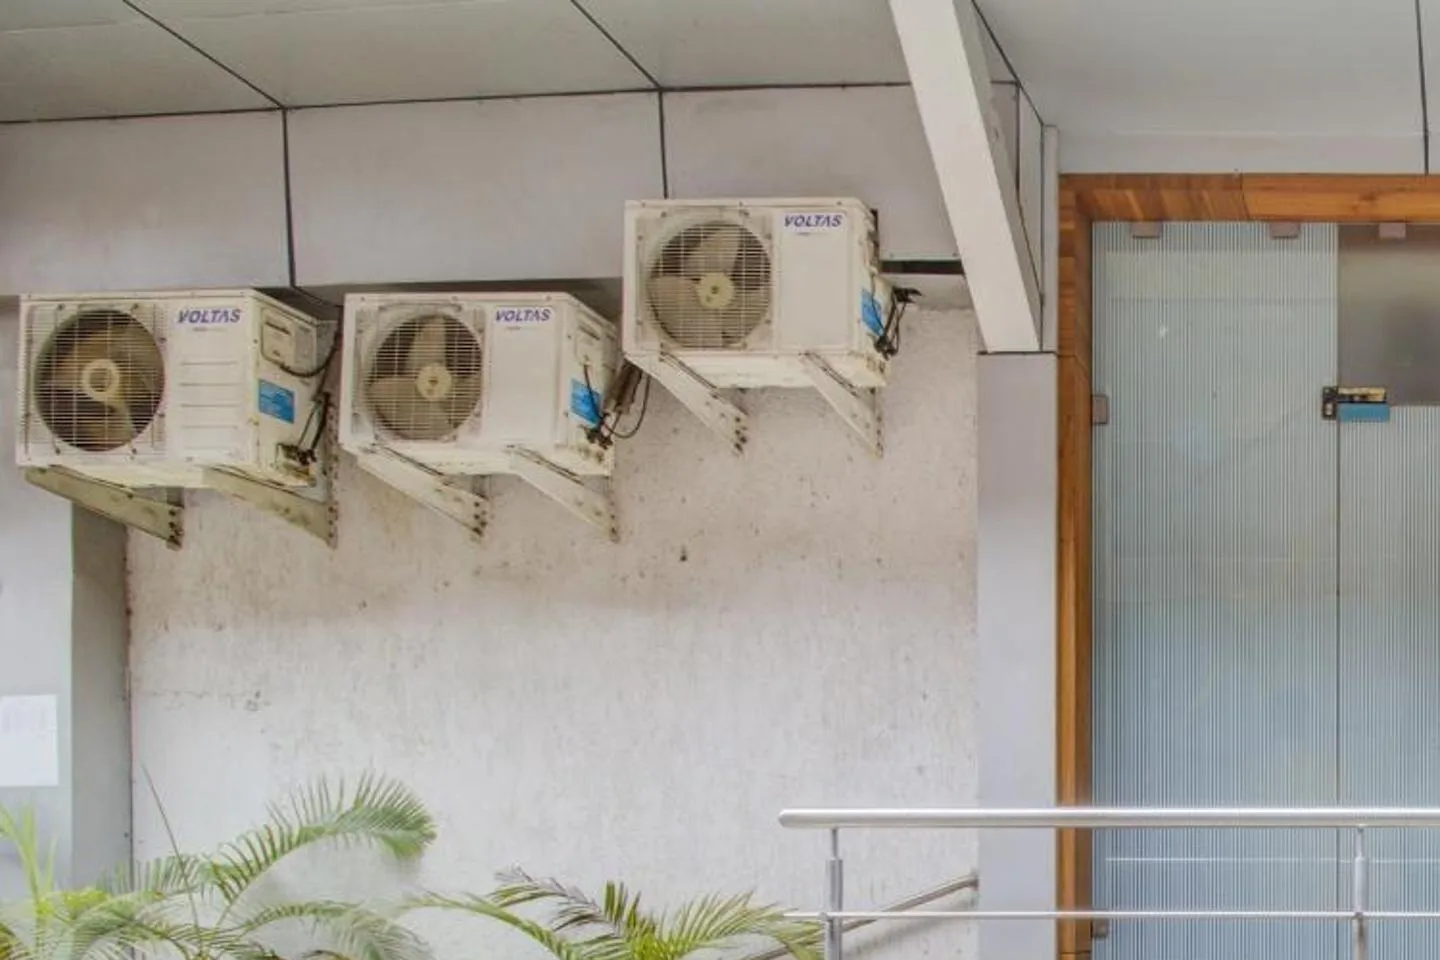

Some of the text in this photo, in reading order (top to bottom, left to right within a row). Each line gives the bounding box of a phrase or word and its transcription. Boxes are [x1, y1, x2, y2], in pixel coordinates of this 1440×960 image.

[783, 214, 843, 228] VOLTAS
[178, 308, 242, 324] VOLTAS
[495, 308, 552, 322] VOLTAS
